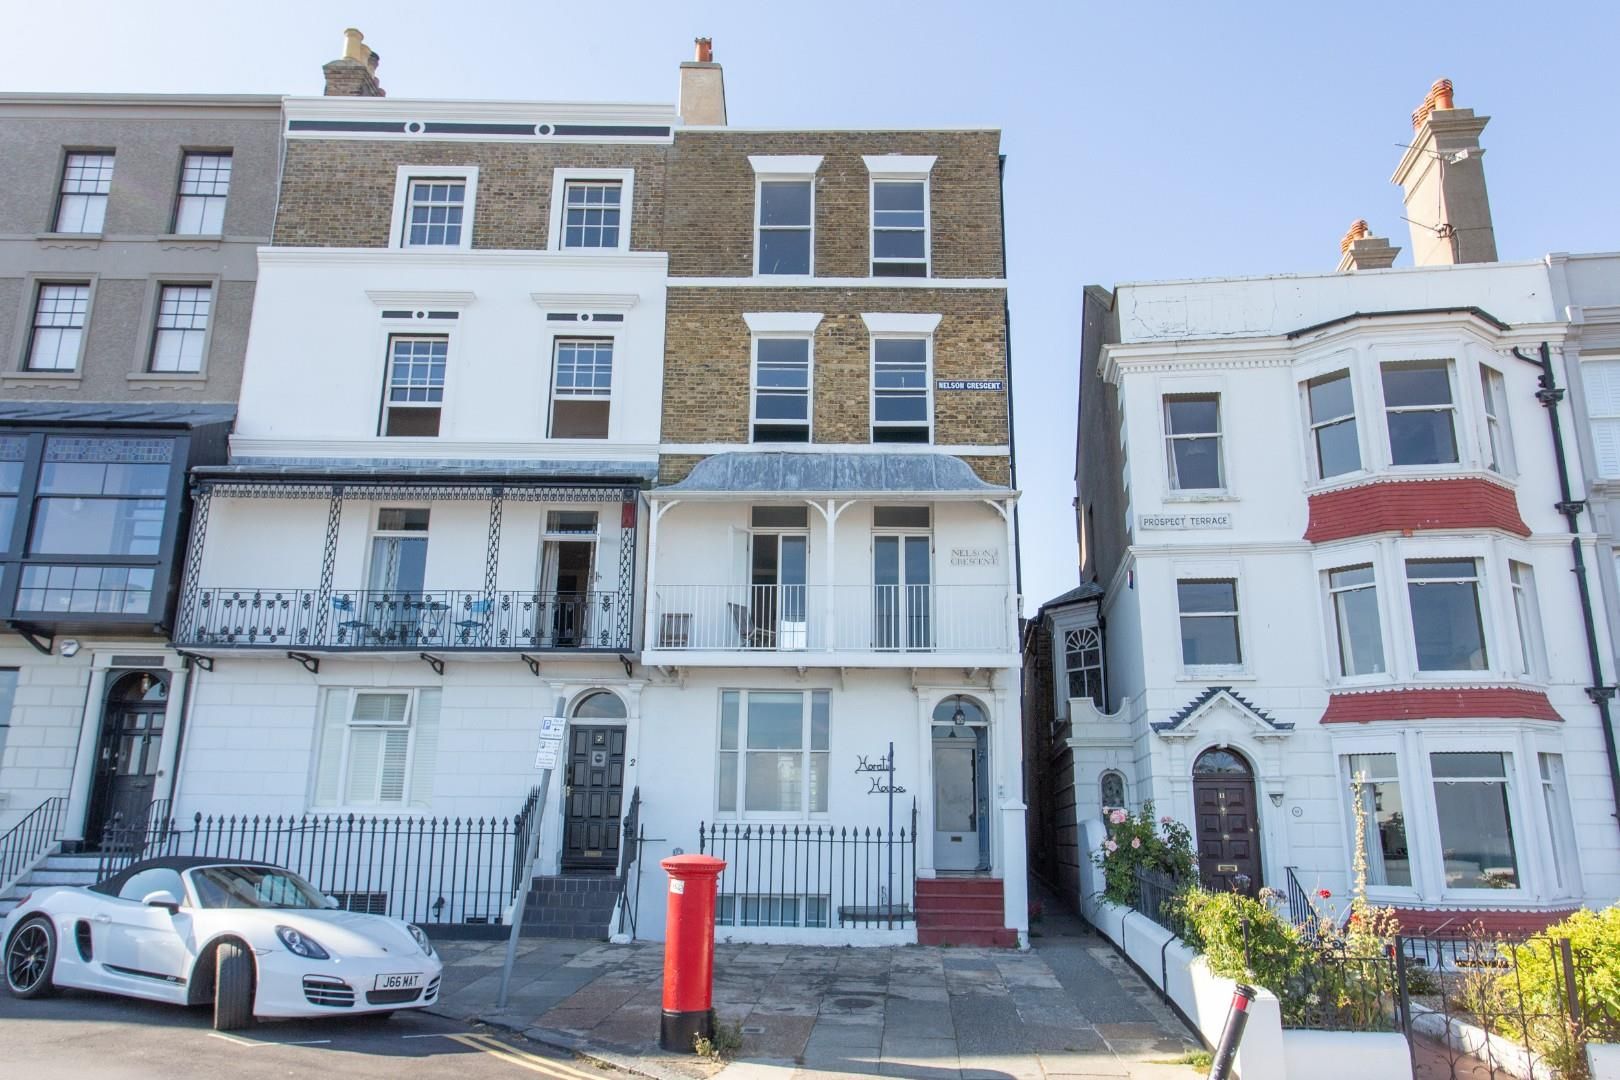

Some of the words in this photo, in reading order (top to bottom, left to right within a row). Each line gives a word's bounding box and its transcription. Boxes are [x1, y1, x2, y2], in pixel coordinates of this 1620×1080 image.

[966, 382, 1001, 390] CRESCENT
[1143, 517, 1185, 526] PROSPECT
[1189, 516, 1228, 525] TERRACE
[629, 758, 636, 767] 2
[855, 754, 896, 774] Horati
[383, 976, 401, 988] J66
[402, 975, 419, 987] MAT
